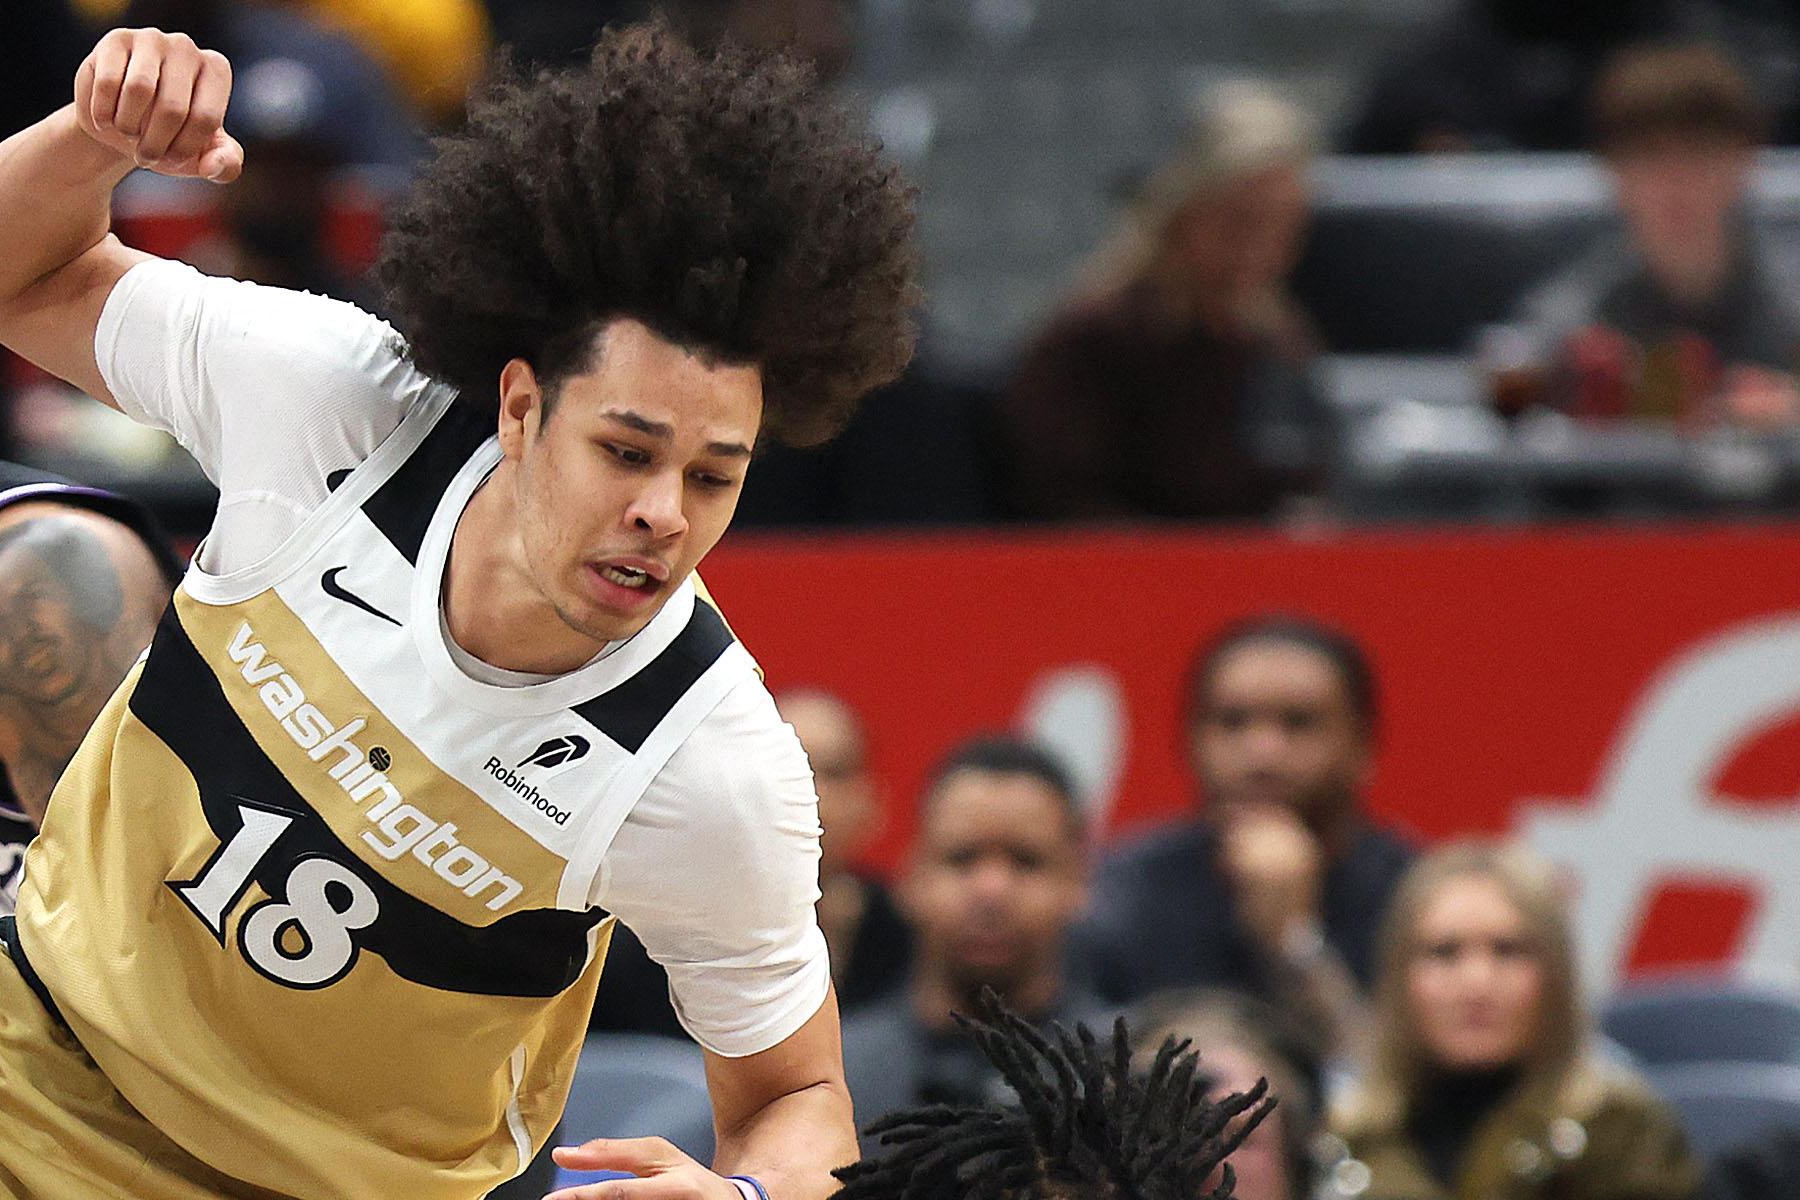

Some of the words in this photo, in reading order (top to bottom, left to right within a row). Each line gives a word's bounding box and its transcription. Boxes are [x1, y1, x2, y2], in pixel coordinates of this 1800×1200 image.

[226, 622, 525, 911] washington
[482, 755, 573, 828] Robinhood
[174, 803, 382, 987] 18
